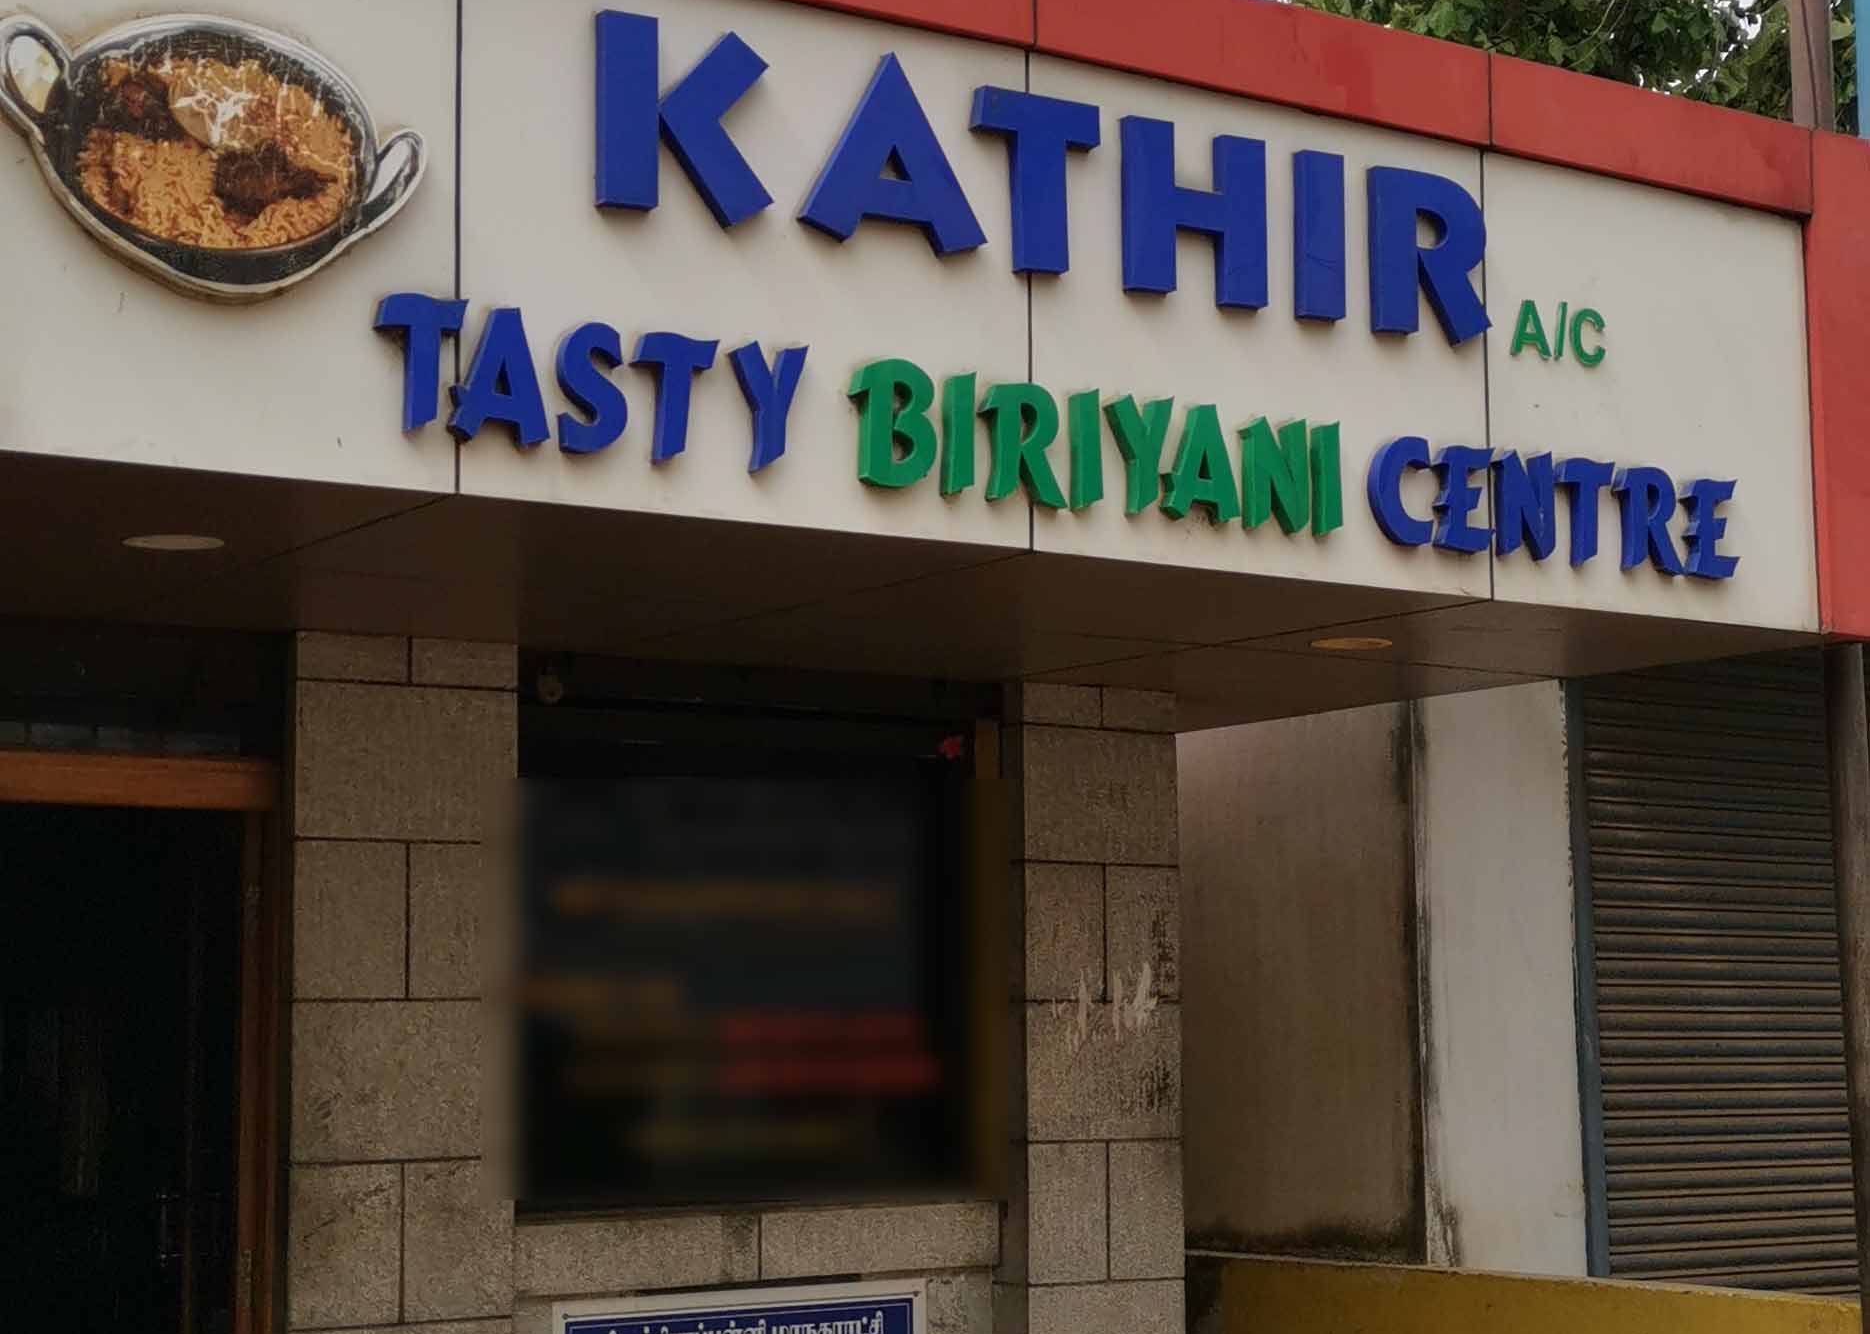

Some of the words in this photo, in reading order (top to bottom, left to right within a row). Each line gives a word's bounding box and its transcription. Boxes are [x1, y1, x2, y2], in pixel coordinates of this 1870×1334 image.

[595, 9, 1491, 349] KATHIR
[372, 292, 810, 475] TASTY
[847, 358, 1343, 537] BIRIYANI
[1367, 435, 1740, 580] CENTRE
[1510, 299, 1606, 367] A/C
